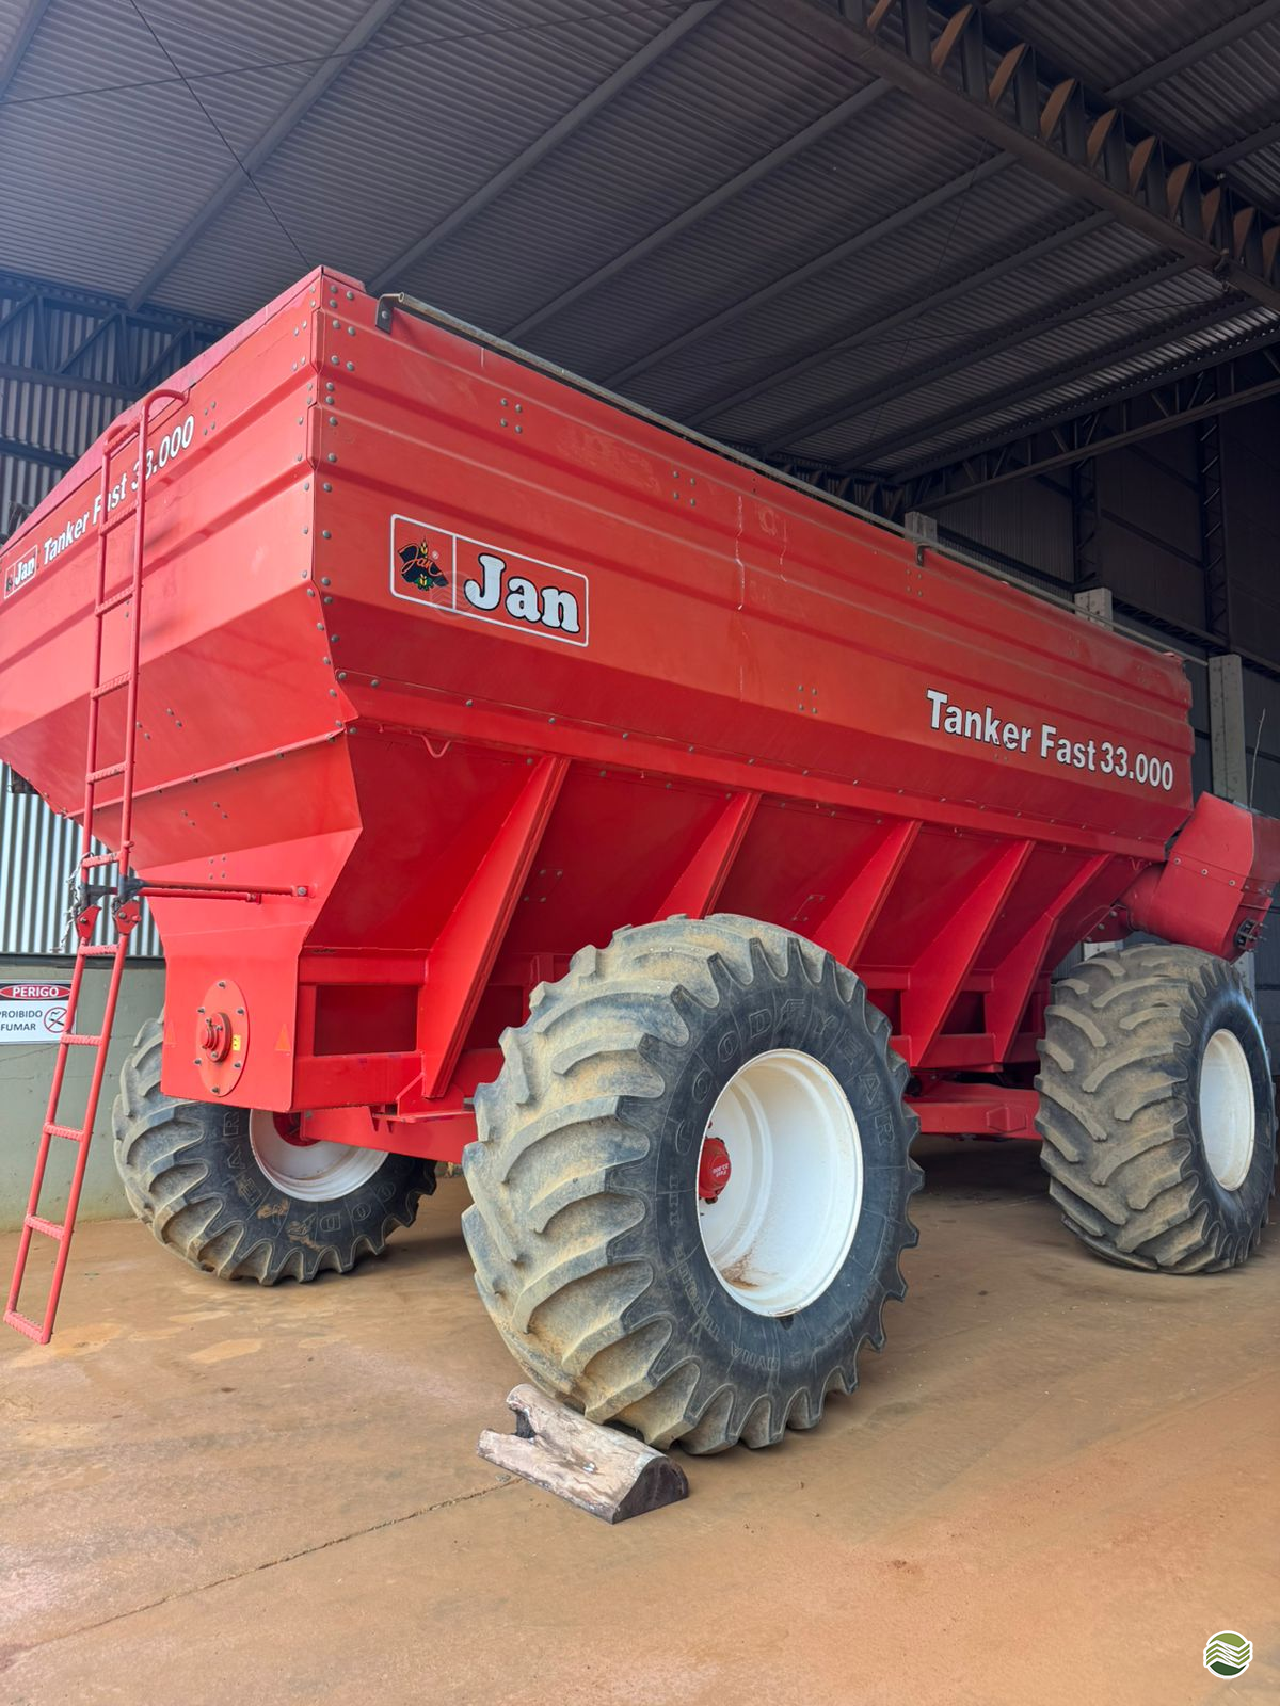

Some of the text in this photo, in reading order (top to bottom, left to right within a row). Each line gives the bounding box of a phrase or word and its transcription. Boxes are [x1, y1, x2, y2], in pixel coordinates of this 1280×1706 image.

[44, 511, 90, 565] Tanker
[15, 558, 35, 585] Jan
[464, 553, 580, 633] Jan
[926, 688, 1174, 791] Tanker Fast 33.000
[12, 986, 60, 997] PERIGO
[0, 1023, 36, 1031] FUMAR
[674, 1006, 896, 1155] GOODYEAR
